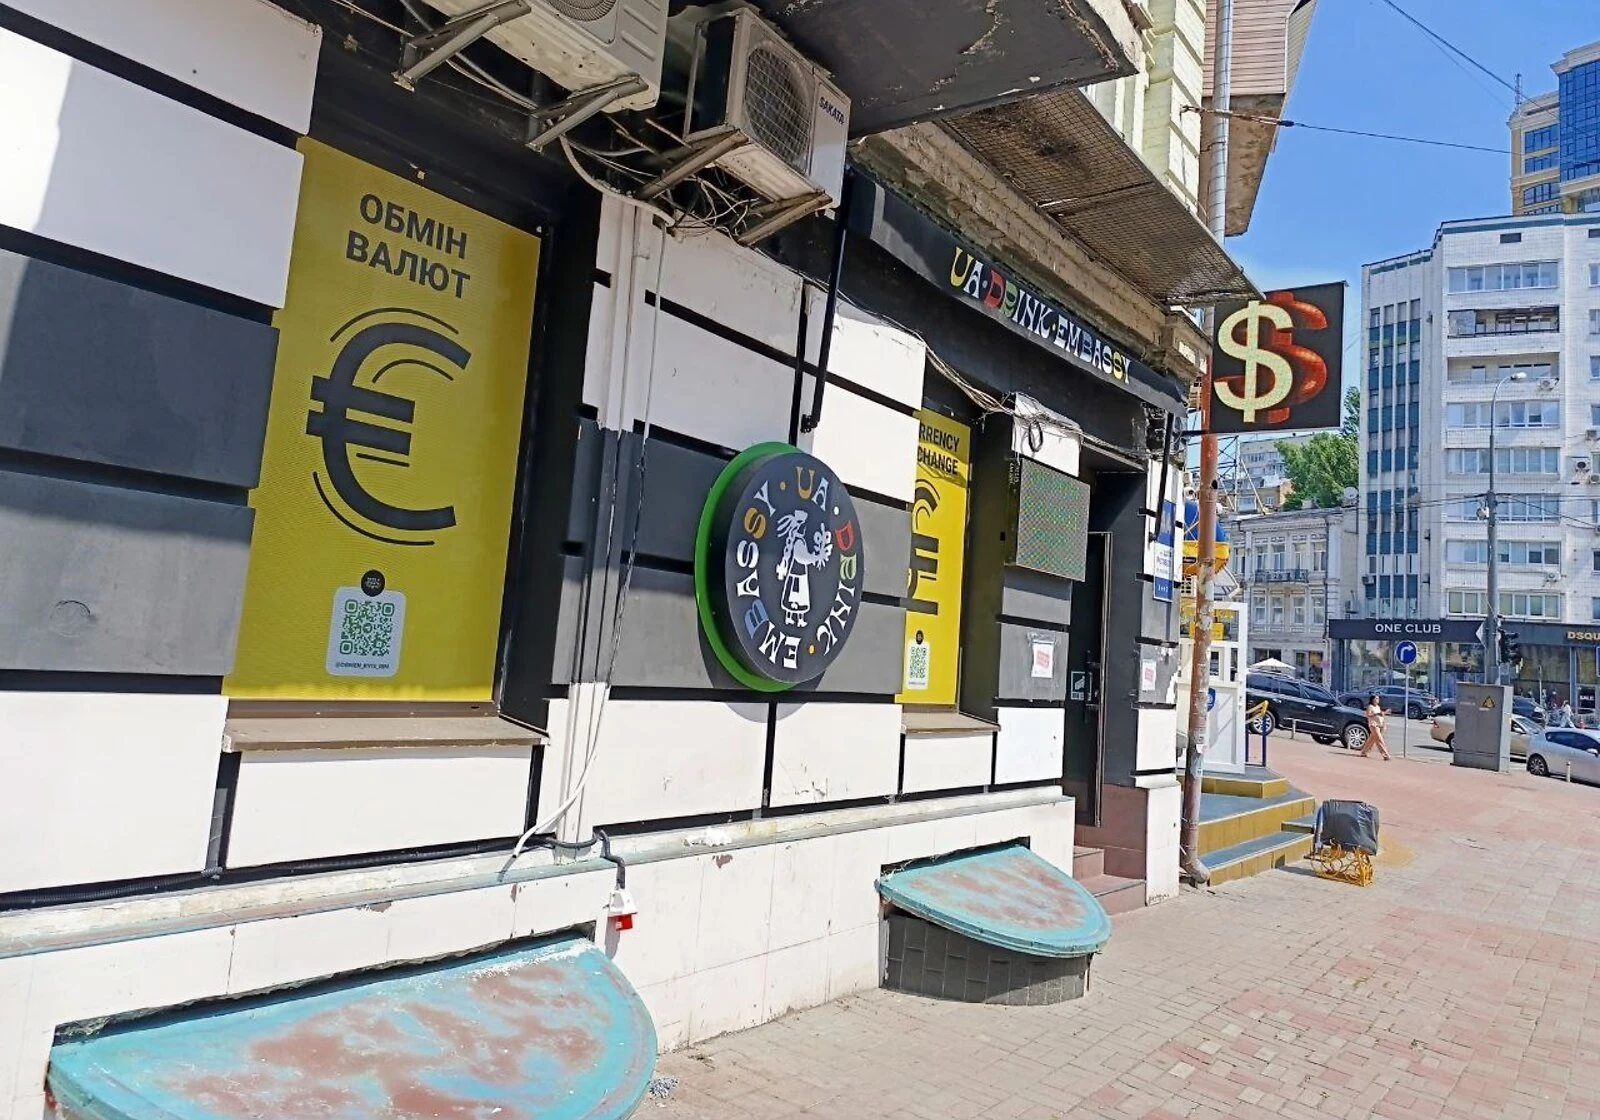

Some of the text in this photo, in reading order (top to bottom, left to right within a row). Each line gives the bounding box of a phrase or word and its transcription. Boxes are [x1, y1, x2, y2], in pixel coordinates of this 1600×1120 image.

[819, 96, 845, 125] SAKATA
[359, 193, 468, 260] ОБМІН
[346, 229, 471, 299] ВАЛЮТ
[950, 246, 1131, 385] UA DRINK EMBASSY
[736, 466, 858, 670] UA DRINK EMBASSY
[1374, 623, 1442, 634] ONE CLUB
